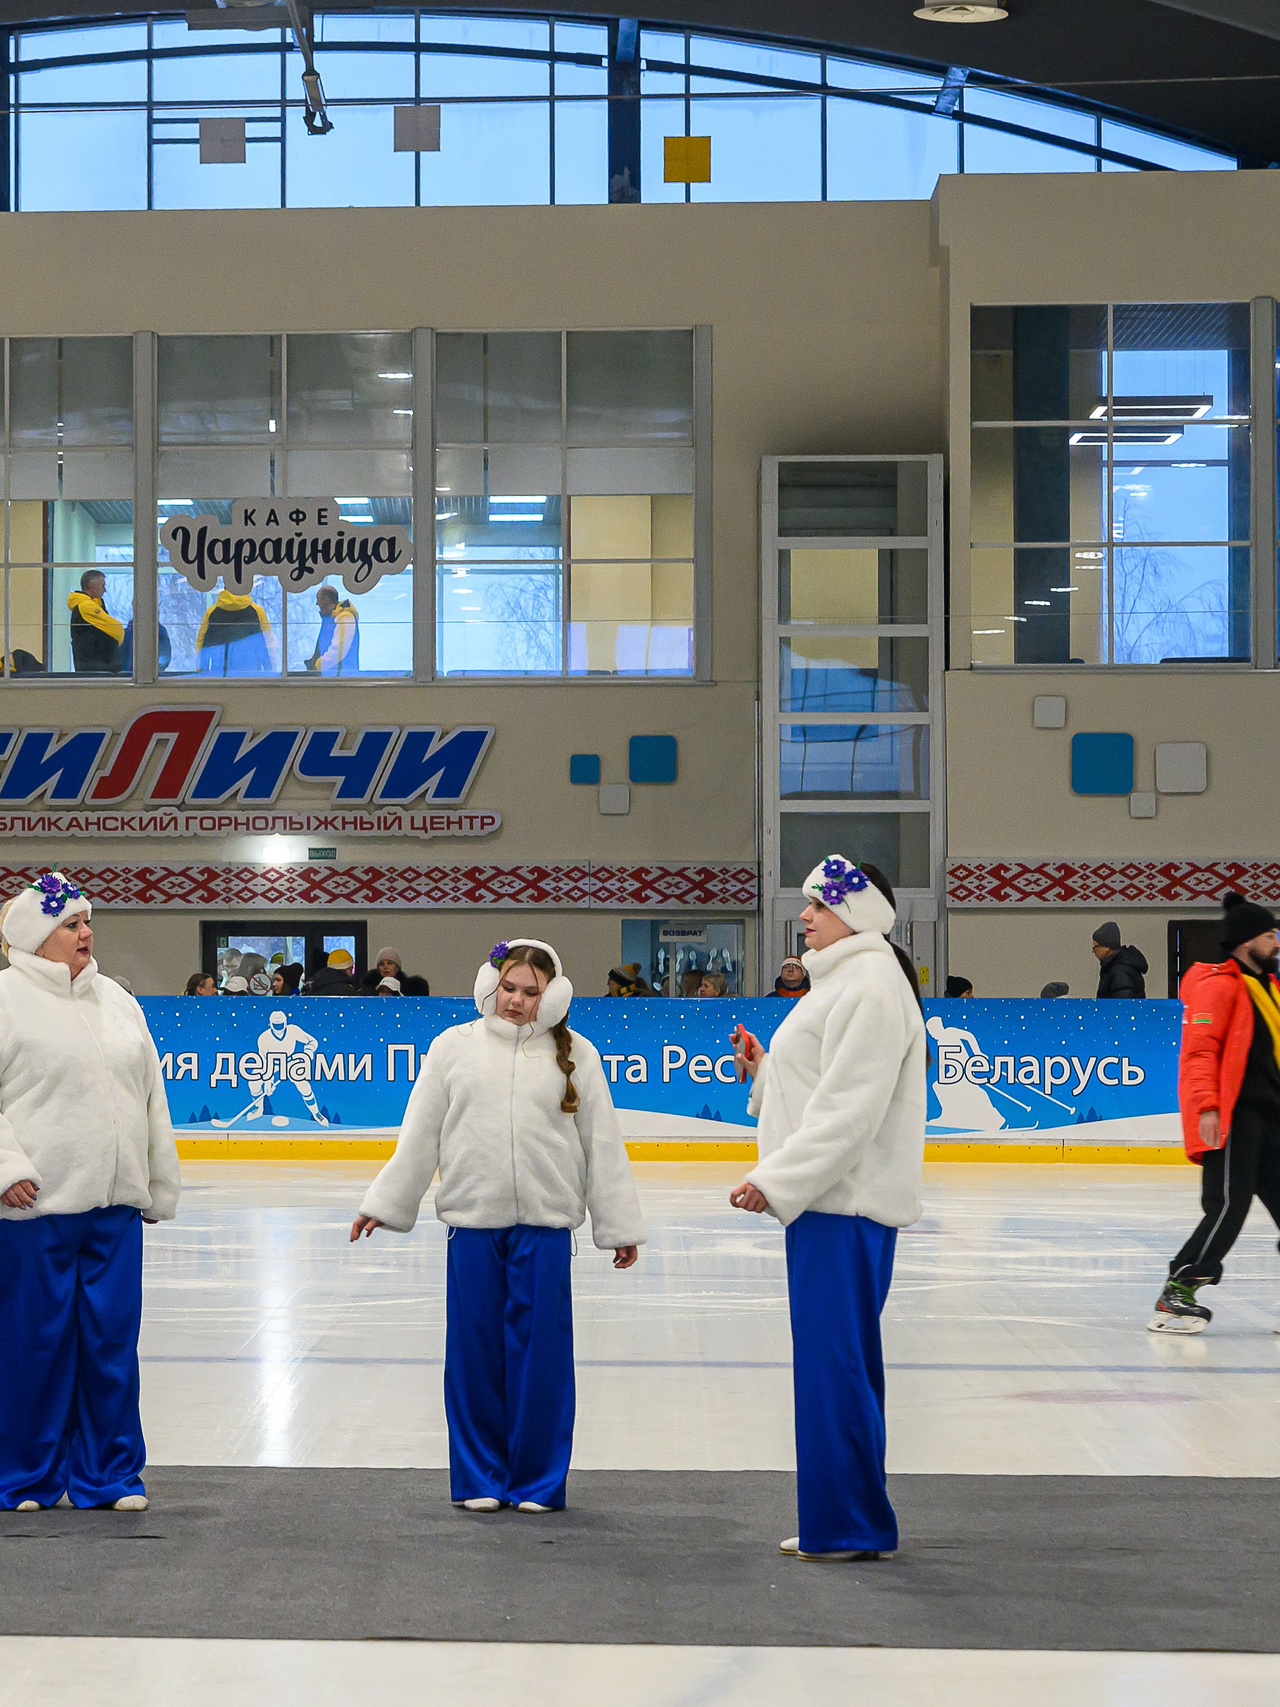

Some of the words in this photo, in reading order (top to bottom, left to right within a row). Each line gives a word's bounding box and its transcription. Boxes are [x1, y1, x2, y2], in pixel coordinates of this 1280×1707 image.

[243, 508, 329, 526] КАФЕ
[170, 525, 403, 585] Чараўніца
[185, 812, 403, 832] ГОРНОЛЫЖНЫЙ
[410, 814, 496, 834] ЦЕНТР
[309, 850, 336, 858] ВЫХОД
[662, 929, 704, 937] ВОЗВРАТ
[209, 1051, 374, 1089] делами
[937, 1044, 1146, 1097] Беларусь
